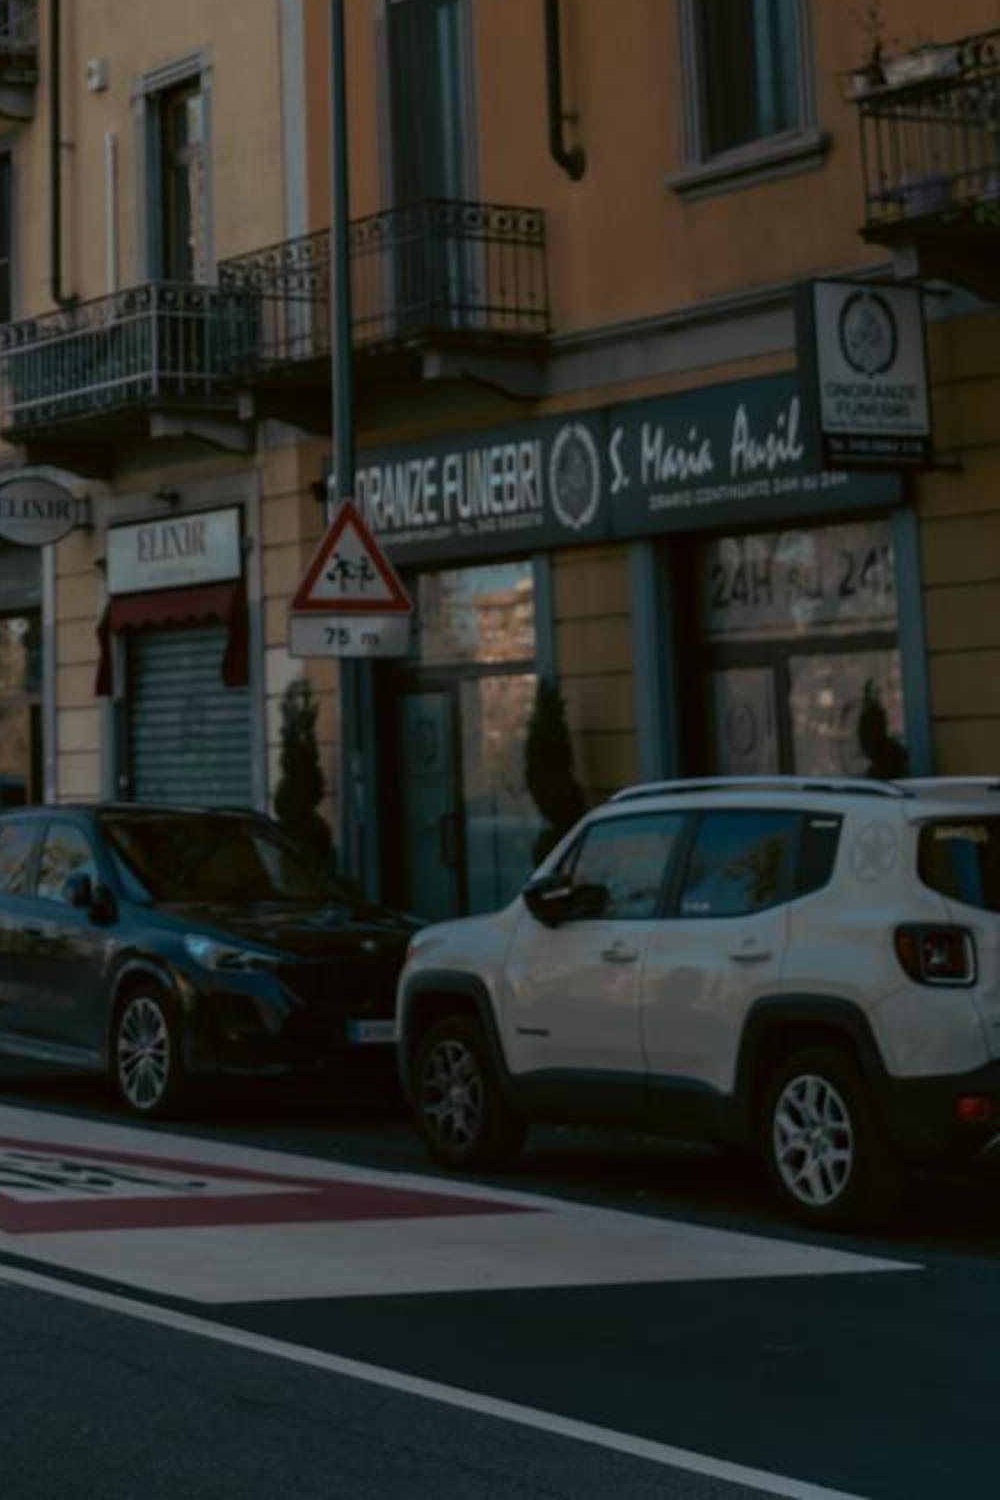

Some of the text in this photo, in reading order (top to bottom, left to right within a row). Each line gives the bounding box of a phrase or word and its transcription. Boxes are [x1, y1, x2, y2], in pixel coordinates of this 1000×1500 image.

[609, 426, 630, 494] S.
[641, 421, 714, 484] Maria
[329, 456, 438, 533] ORANZE
[442, 440, 545, 520] FUNEBRI
[137, 521, 206, 563] ELIXIR
[712, 558, 773, 608] 24H
[325, 627, 379, 645] 75 m
